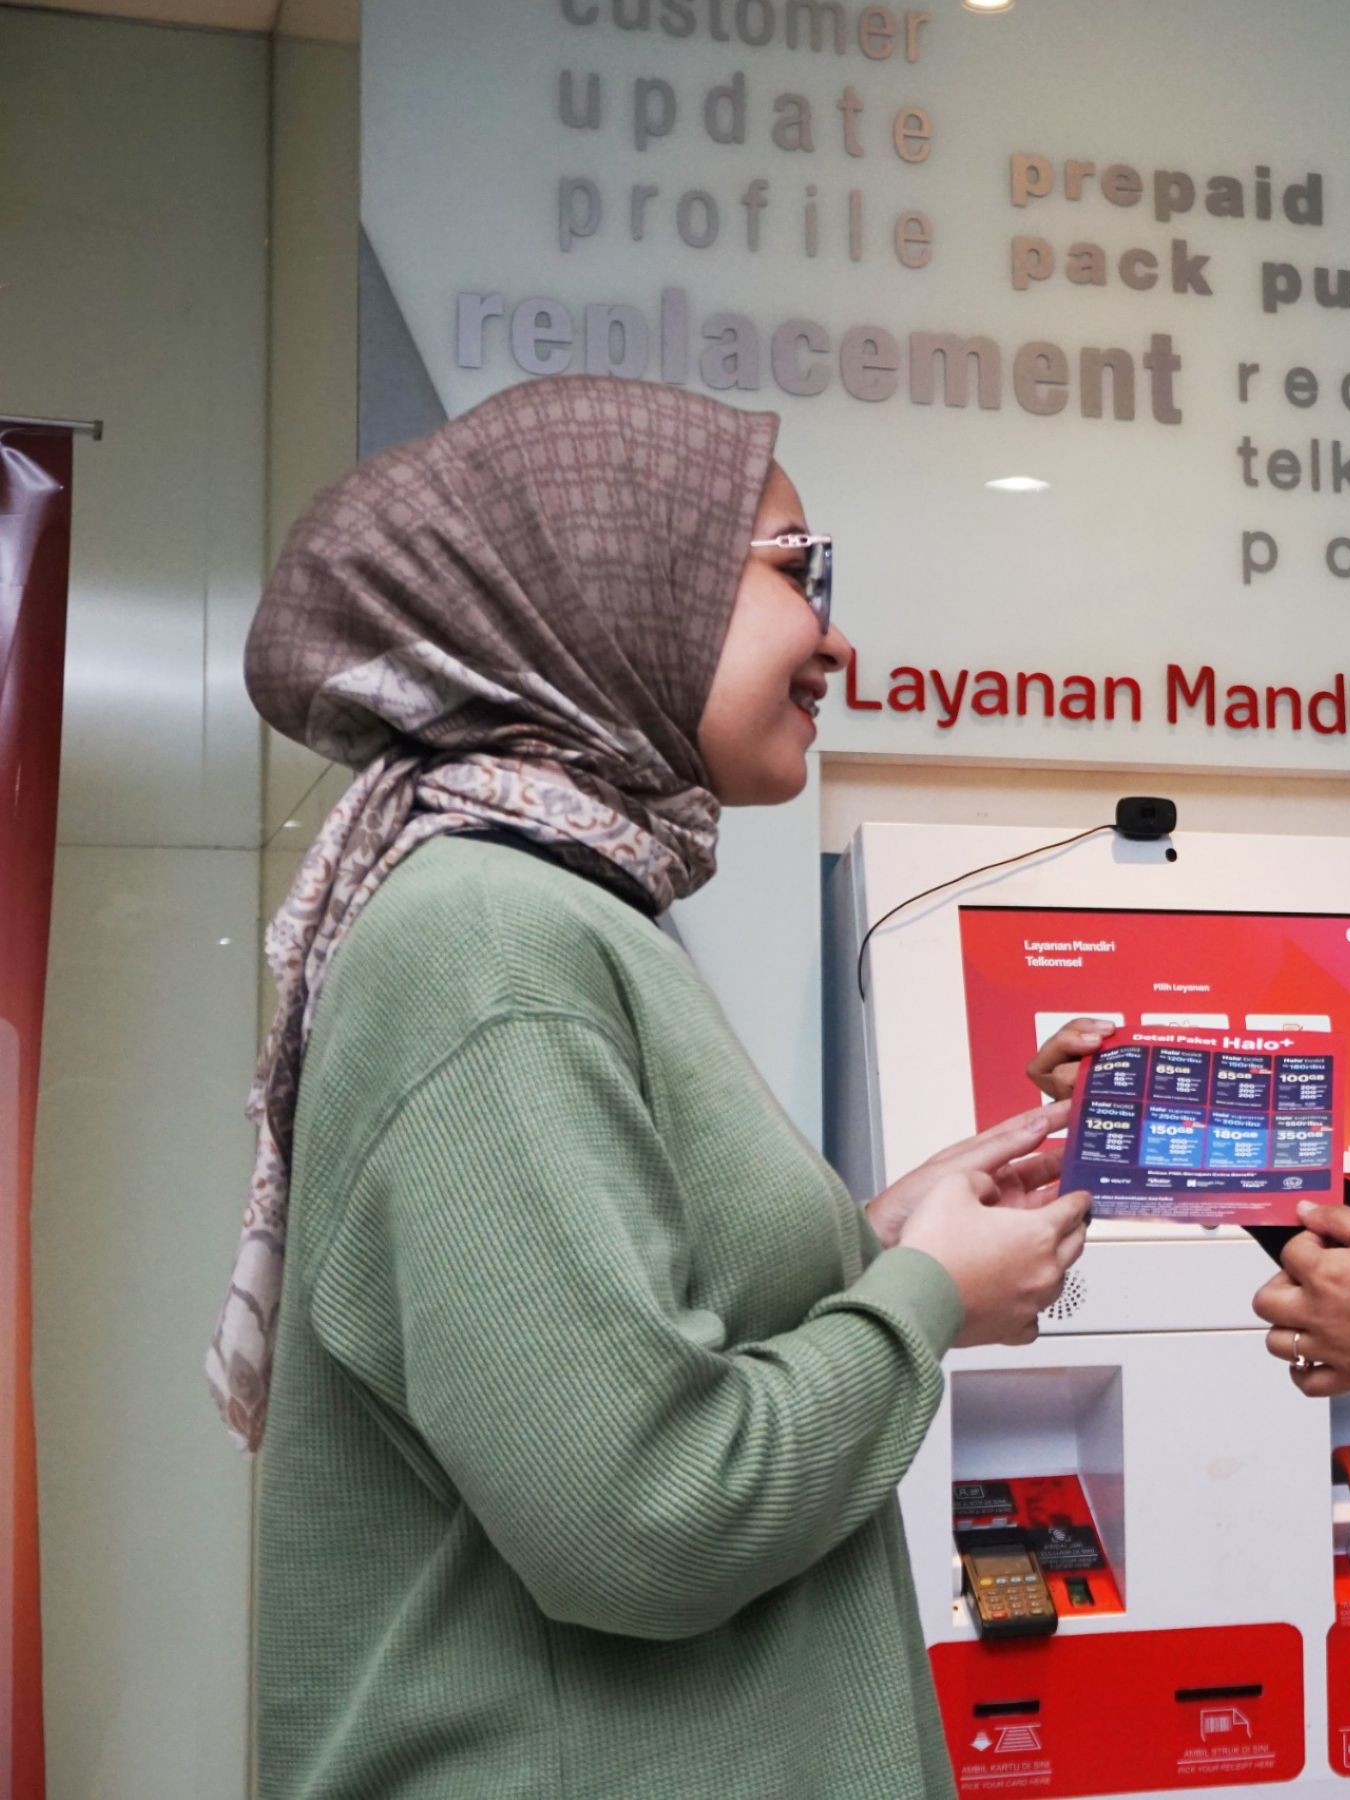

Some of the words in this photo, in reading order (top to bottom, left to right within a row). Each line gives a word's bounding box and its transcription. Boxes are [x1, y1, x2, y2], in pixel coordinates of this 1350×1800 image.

[559, 69, 933, 162] update
[1010, 153, 1324, 226] prepaid
[558, 175, 933, 268] profile
[1011, 235, 1213, 295] pack
[456, 287, 1182, 424] replacement
[846, 647, 1142, 728] Layanan
[1024, 940, 1071, 952] Layanan
[1073, 941, 1115, 952] Mandiri
[1026, 956, 1082, 967] Telkomsel
[1153, 983, 1172, 992] Pilih
[1173, 983, 1210, 993] Layanan
[1132, 1033, 1174, 1043] Detail
[1177, 1035, 1217, 1046] Paket
[1223, 1037, 1294, 1050] Halo+
[1156, 1063, 1190, 1074] 65GB
[1280, 1074, 1325, 1083] 100GB
[1085, 1119, 1130, 1130] 120GB
[1149, 1125, 1194, 1135] 150GB
[1213, 1130, 1258, 1140] 180GB
[1211, 1746, 1239, 1756] STRUK
[990, 1762, 1020, 1772] KARTU
